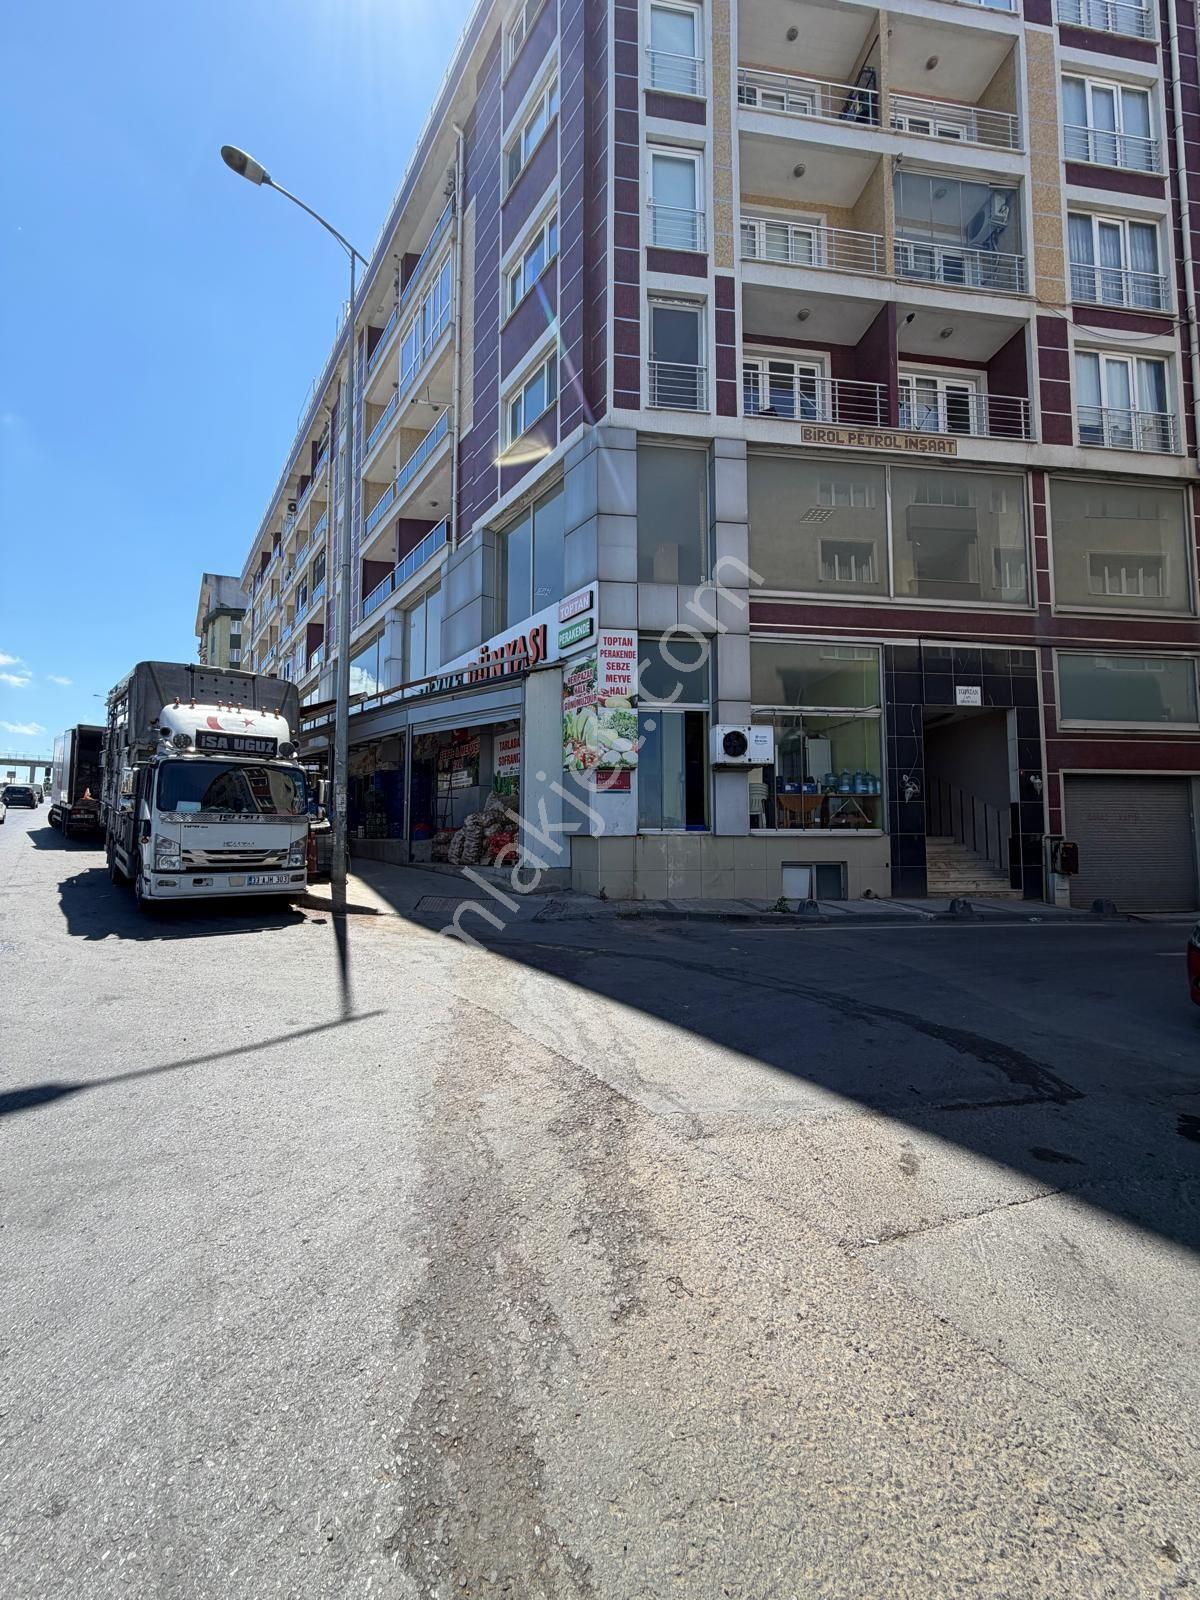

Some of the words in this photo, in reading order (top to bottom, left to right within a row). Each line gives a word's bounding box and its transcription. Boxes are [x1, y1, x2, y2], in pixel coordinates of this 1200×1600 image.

[803, 427, 845, 444] BİROL
[847, 432, 902, 448] PETROL
[904, 436, 955, 453] İNŞAAT
[559, 594, 590, 618] TOPTAN
[559, 622, 590, 645] PERAKENDE
[603, 637, 633, 647] TOPTAN
[467, 624, 547, 683] DÜNYASI
[600, 650, 636, 659] PERAKENDE
[606, 662, 631, 671] SEBZE
[605, 675, 631, 683] MEYVE
[609, 686, 627, 695] HALİ
